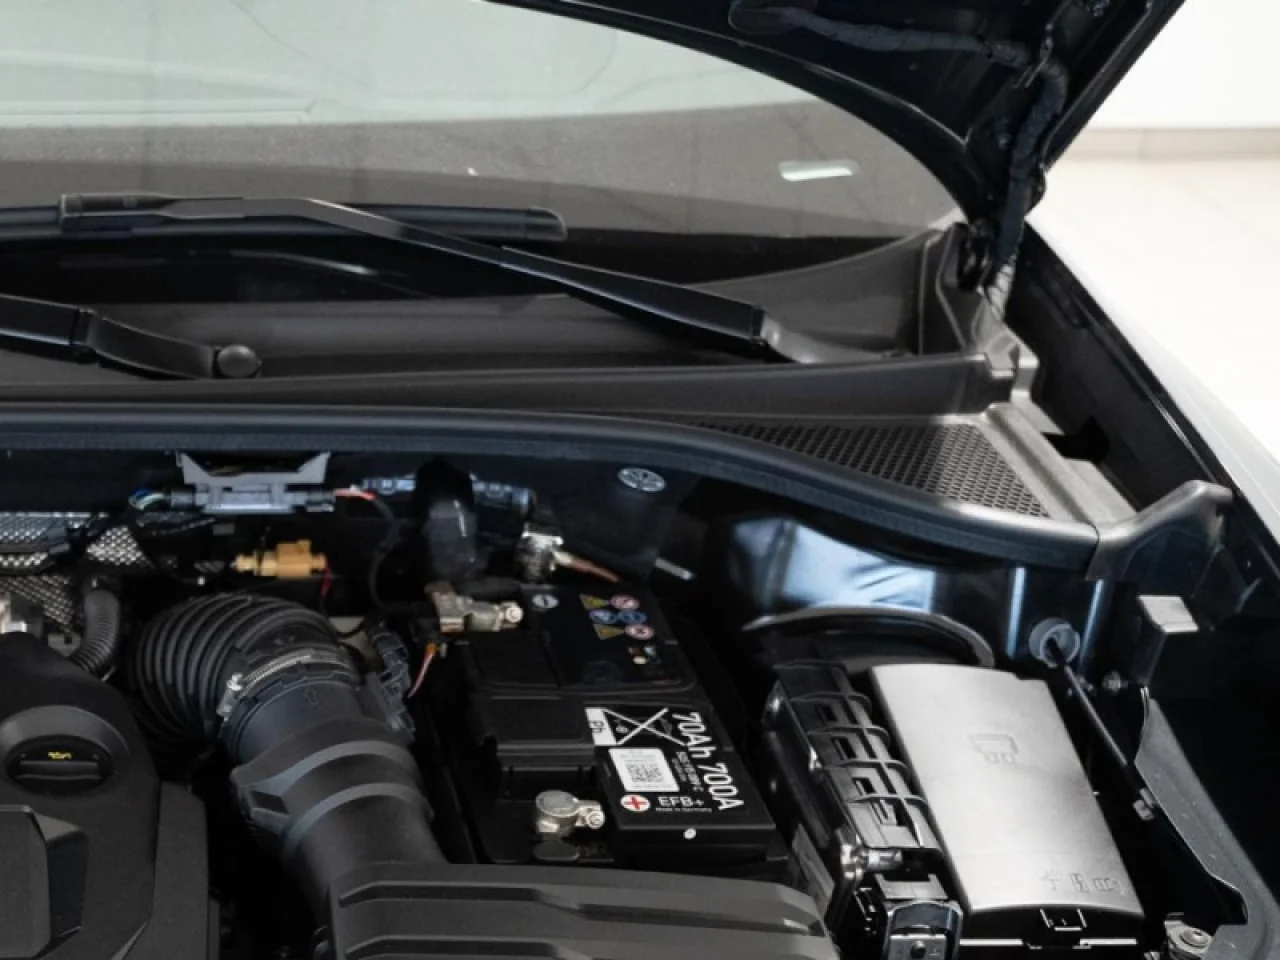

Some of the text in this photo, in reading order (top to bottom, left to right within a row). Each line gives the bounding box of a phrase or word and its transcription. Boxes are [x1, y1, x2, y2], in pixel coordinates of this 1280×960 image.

[672, 712, 717, 758] 70Ah
[697, 762, 744, 810] 700A
[658, 796, 704, 806] EFB+
